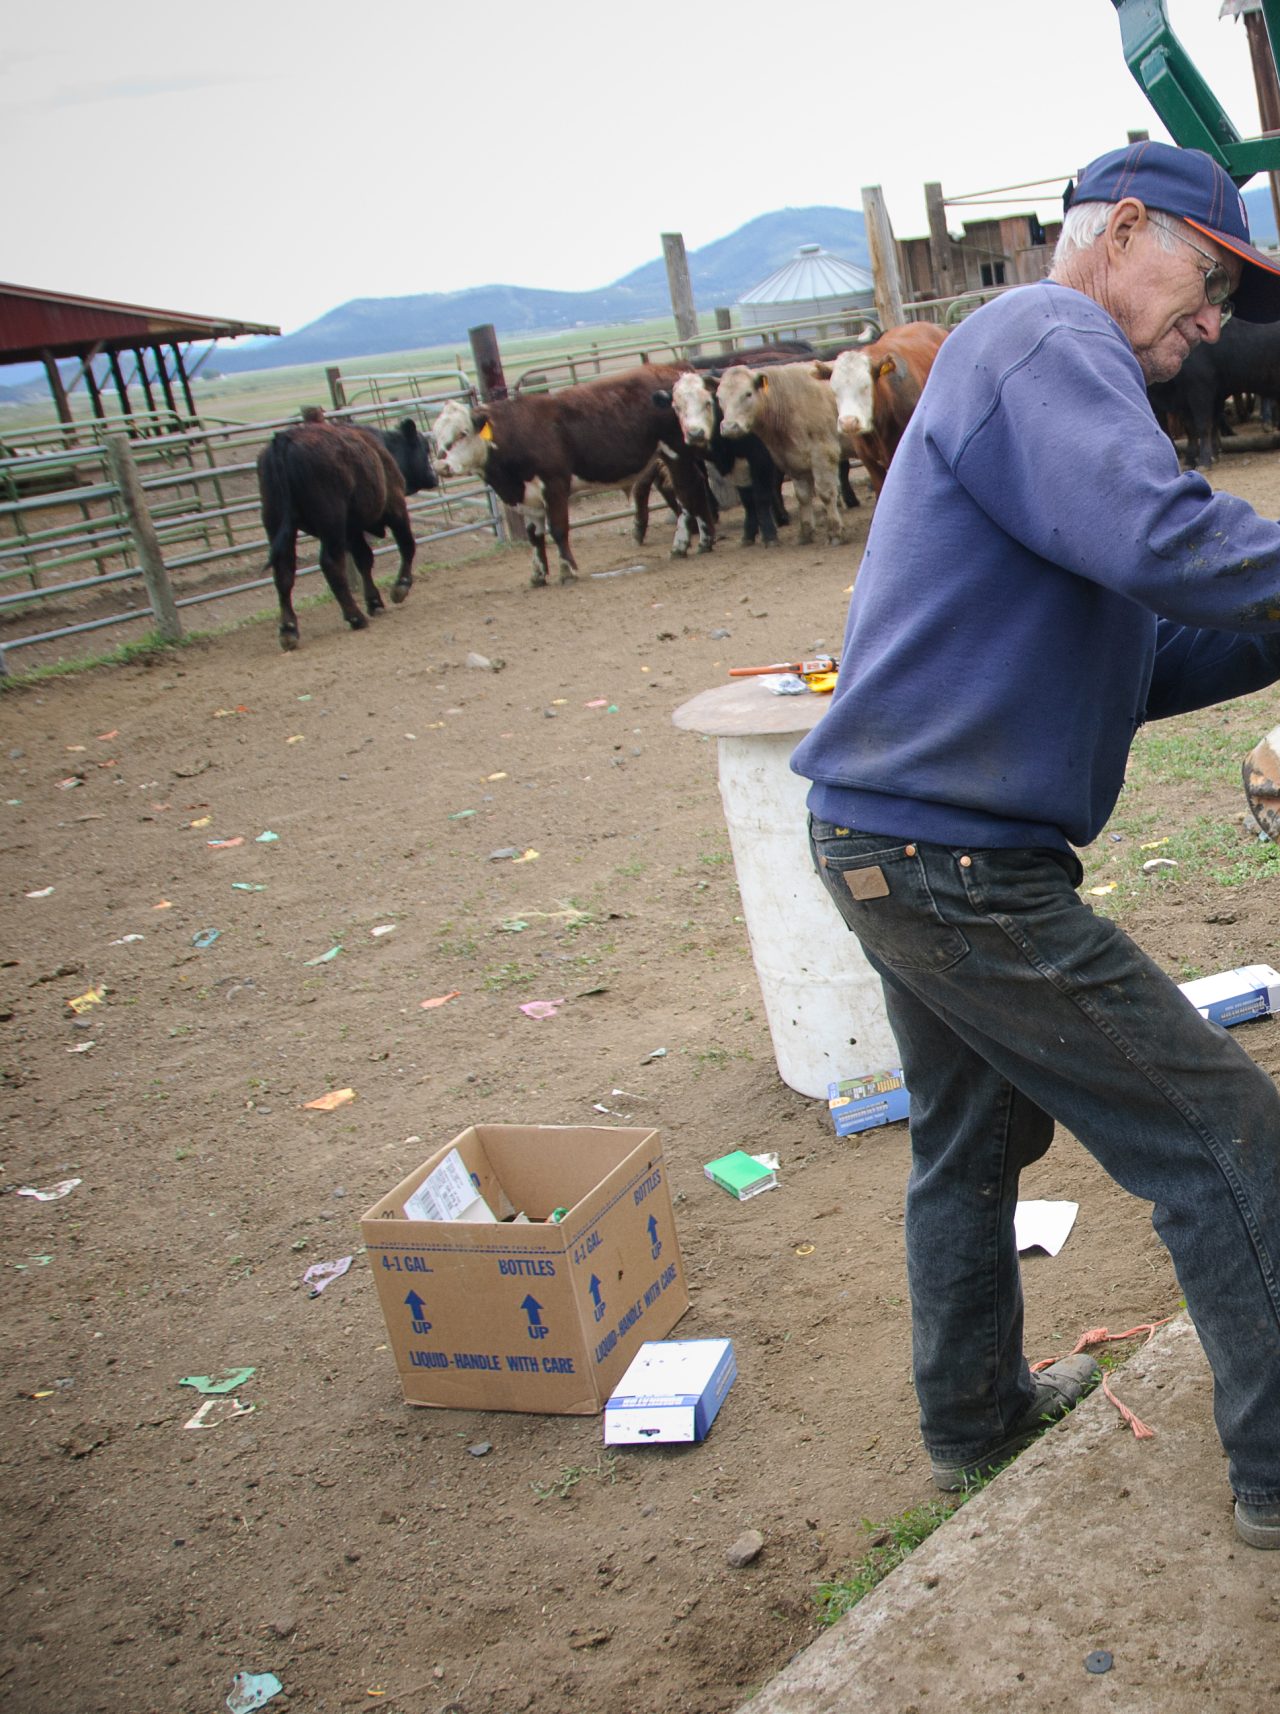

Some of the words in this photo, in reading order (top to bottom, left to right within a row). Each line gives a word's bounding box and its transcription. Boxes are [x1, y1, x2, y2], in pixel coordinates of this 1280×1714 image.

[574, 1243, 587, 1265] 4-1
[632, 1168, 662, 1207] BOTTLES
[651, 1241, 662, 1261] UP
[382, 1255, 403, 1272] 4-1
[404, 1257, 434, 1273] GAL.
[498, 1259, 556, 1276] BOTTLES
[643, 1280, 662, 1309] WITH
[661, 1262, 678, 1291] CARE
[593, 1301, 606, 1323] UP
[411, 1321, 433, 1335] UP
[528, 1325, 549, 1340] UP
[505, 1355, 540, 1373] WITH
[541, 1357, 576, 1374] CARE
